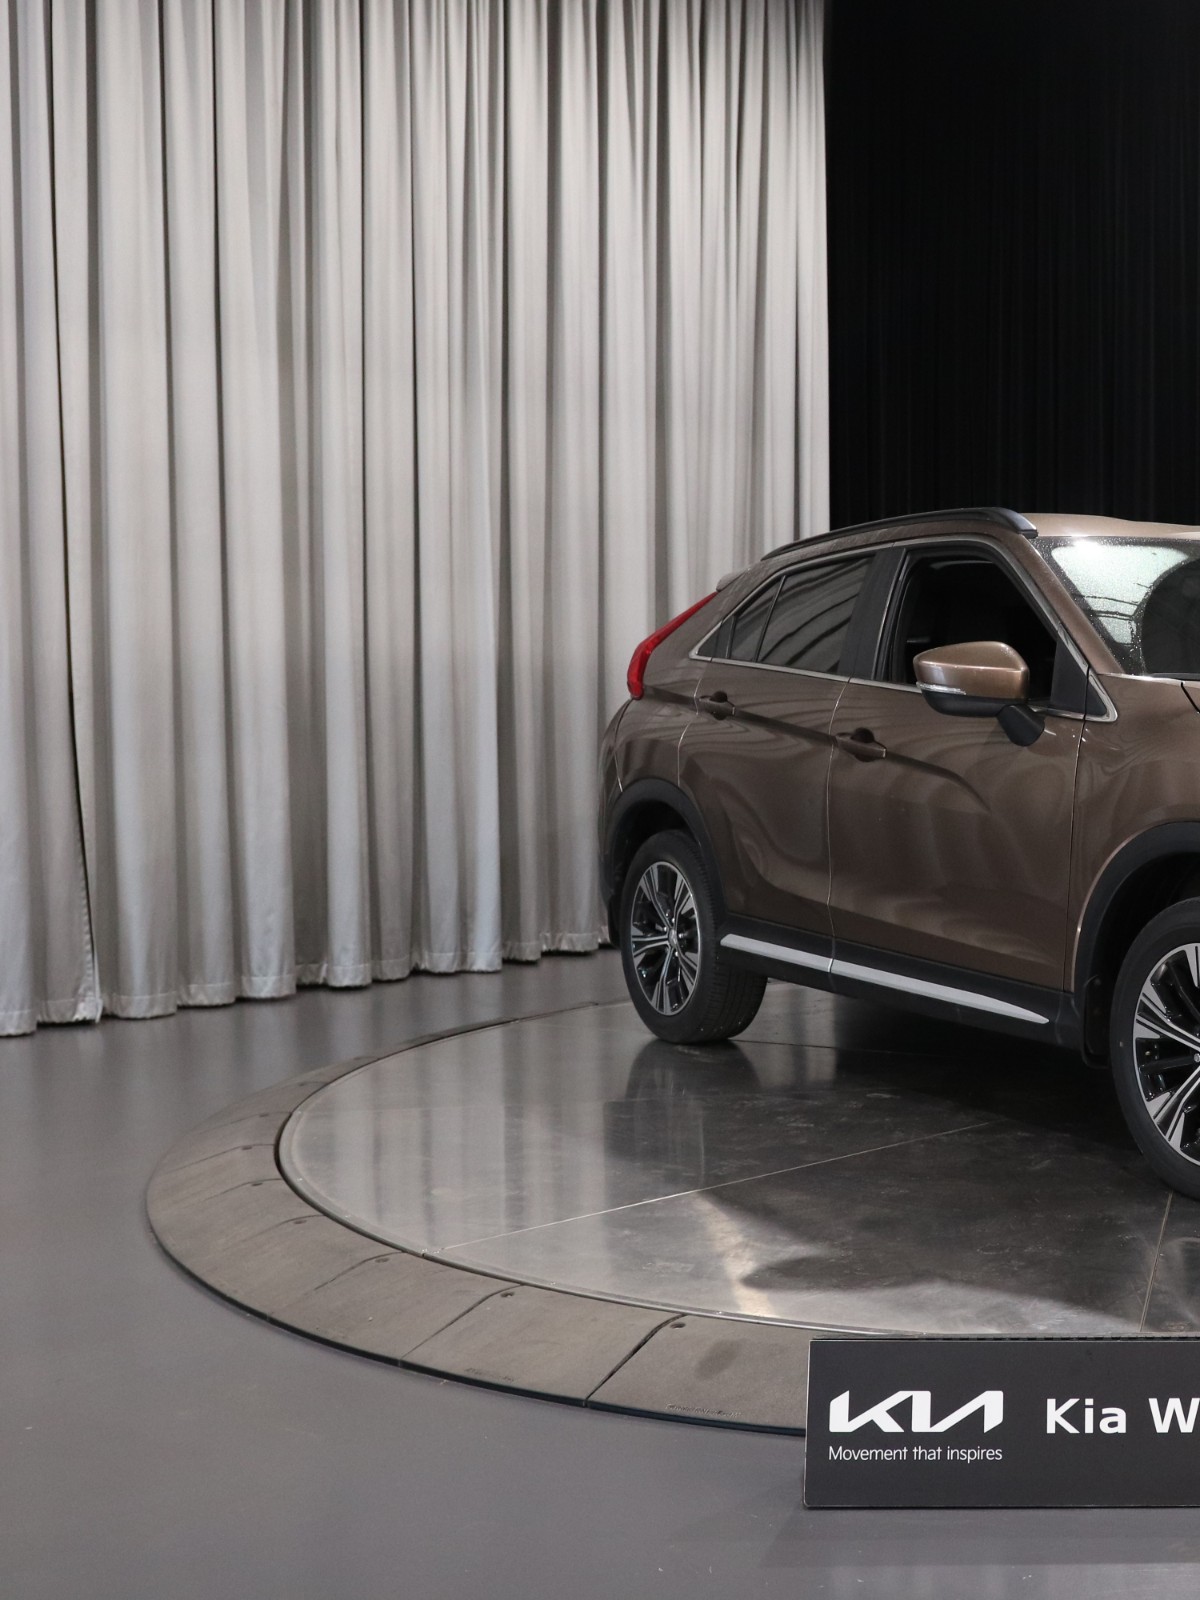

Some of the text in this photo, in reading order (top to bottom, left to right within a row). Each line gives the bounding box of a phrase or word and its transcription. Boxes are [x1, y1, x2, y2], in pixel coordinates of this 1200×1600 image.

[1046, 1397, 1127, 1434] Kia
[828, 1445, 1003, 1464] Movement that inspires
